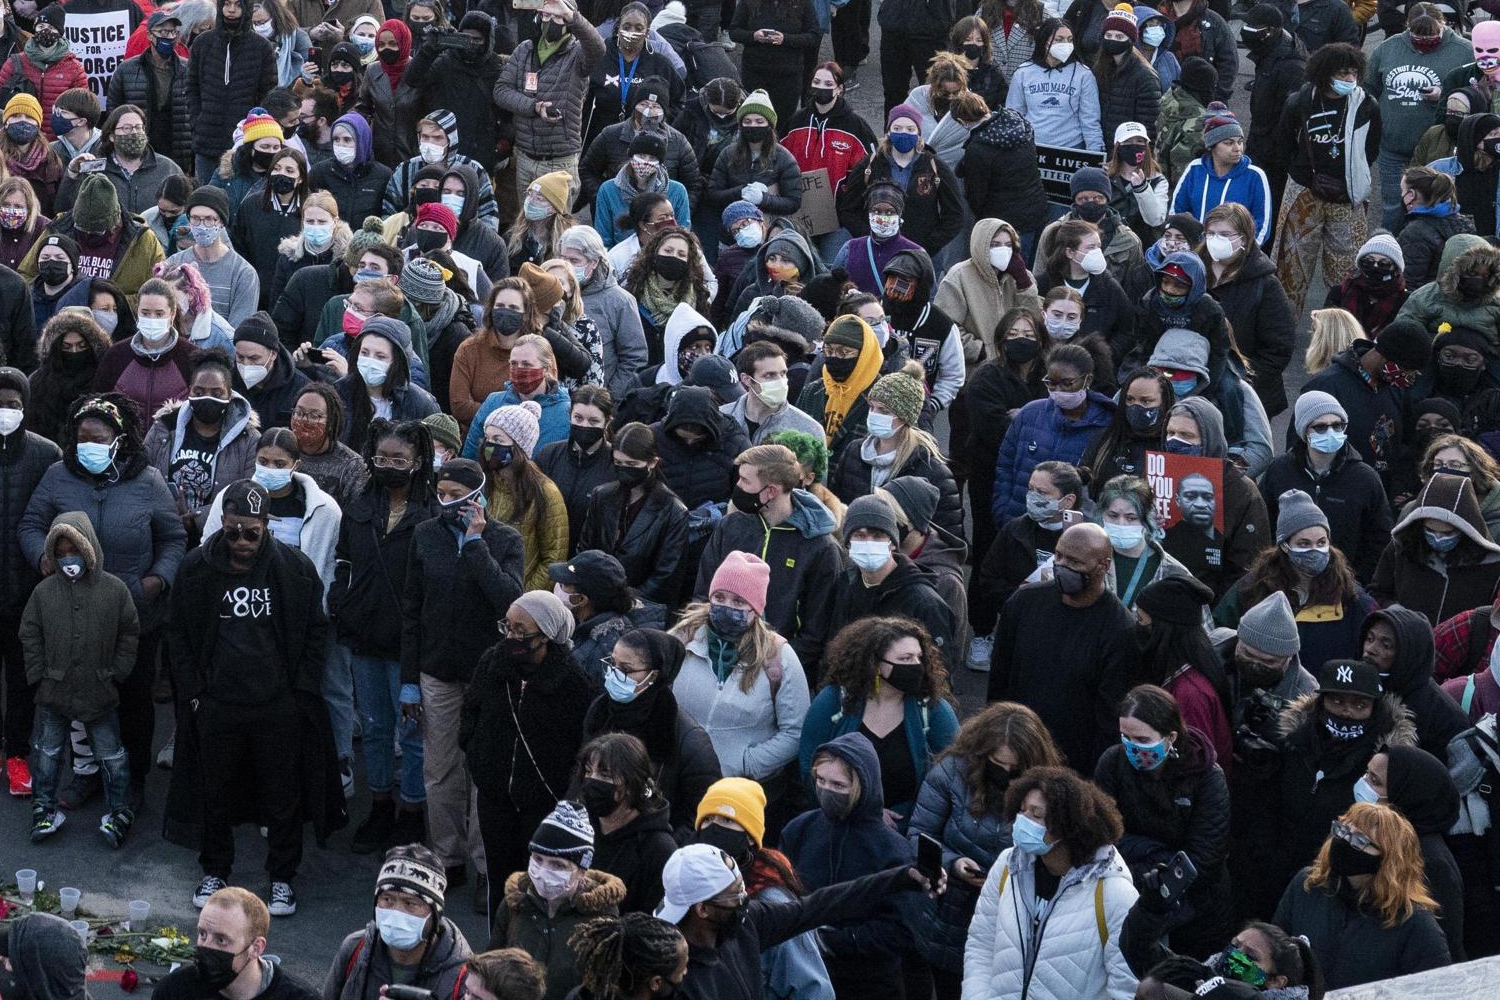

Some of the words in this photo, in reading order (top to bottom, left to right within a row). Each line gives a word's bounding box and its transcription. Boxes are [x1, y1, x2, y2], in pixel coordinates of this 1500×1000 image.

[86, 45, 102, 54] FOR
[1411, 65, 1429, 73] LAKE
[1029, 83, 1051, 95] GRAND
[1050, 82, 1077, 96] MARAIS
[1055, 156, 1089, 169] LIVES
[1147, 453, 1165, 476] DO
[1147, 475, 1173, 499] YOU
[1155, 498, 1171, 519] EE
[1336, 665, 1353, 683] NY
